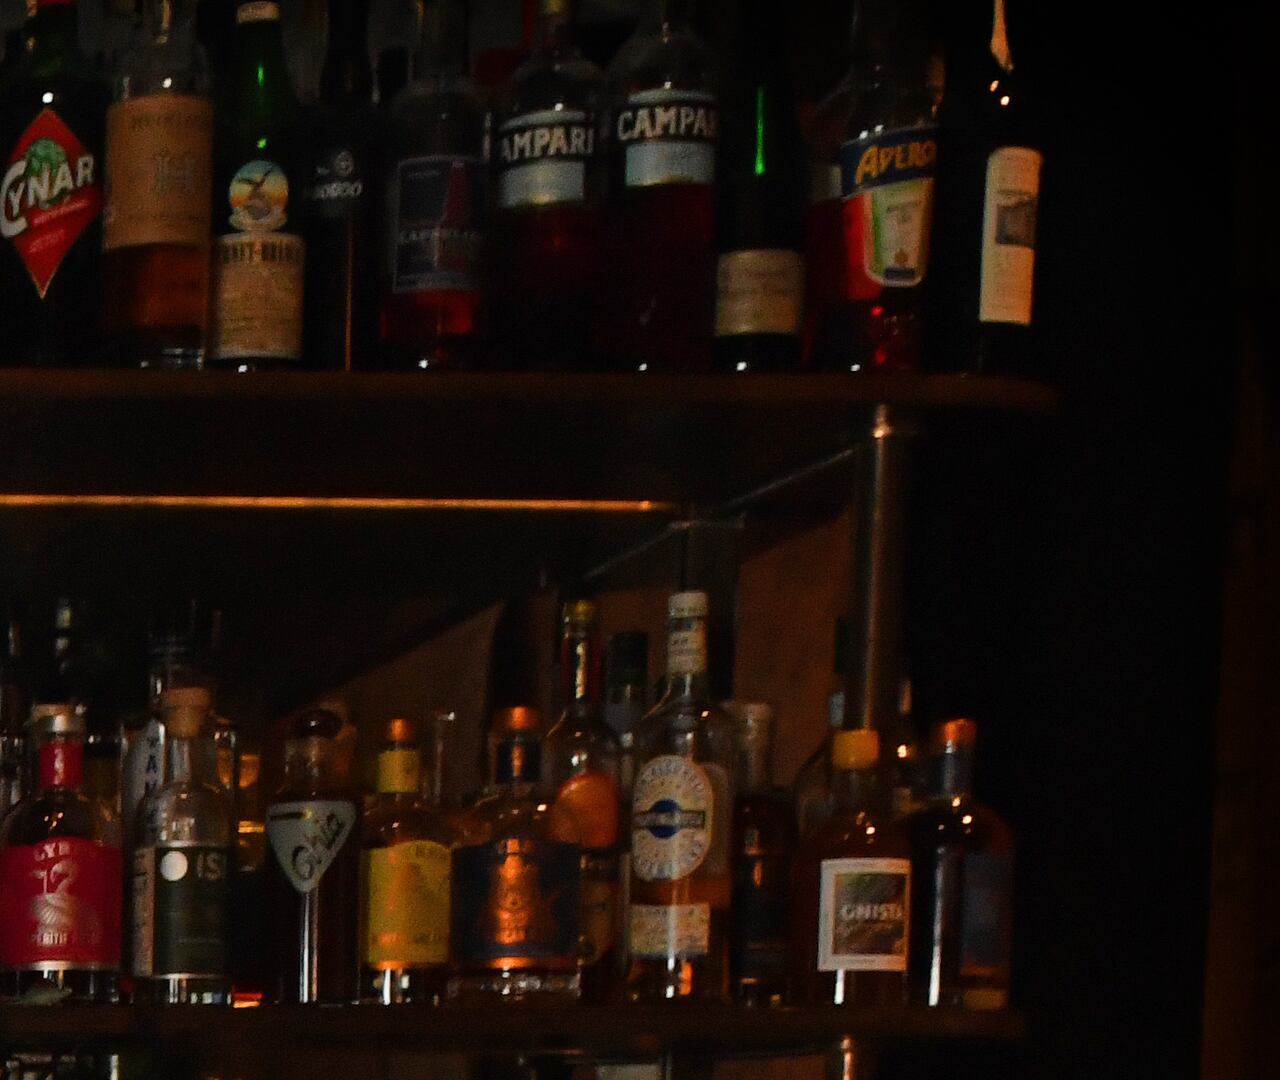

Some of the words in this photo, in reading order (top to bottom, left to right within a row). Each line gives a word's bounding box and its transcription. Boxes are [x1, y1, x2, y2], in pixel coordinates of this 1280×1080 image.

[500, 127, 595, 161] AMPARI
[855, 138, 938, 185] APERO
[0, 154, 95, 239] CYNAR
